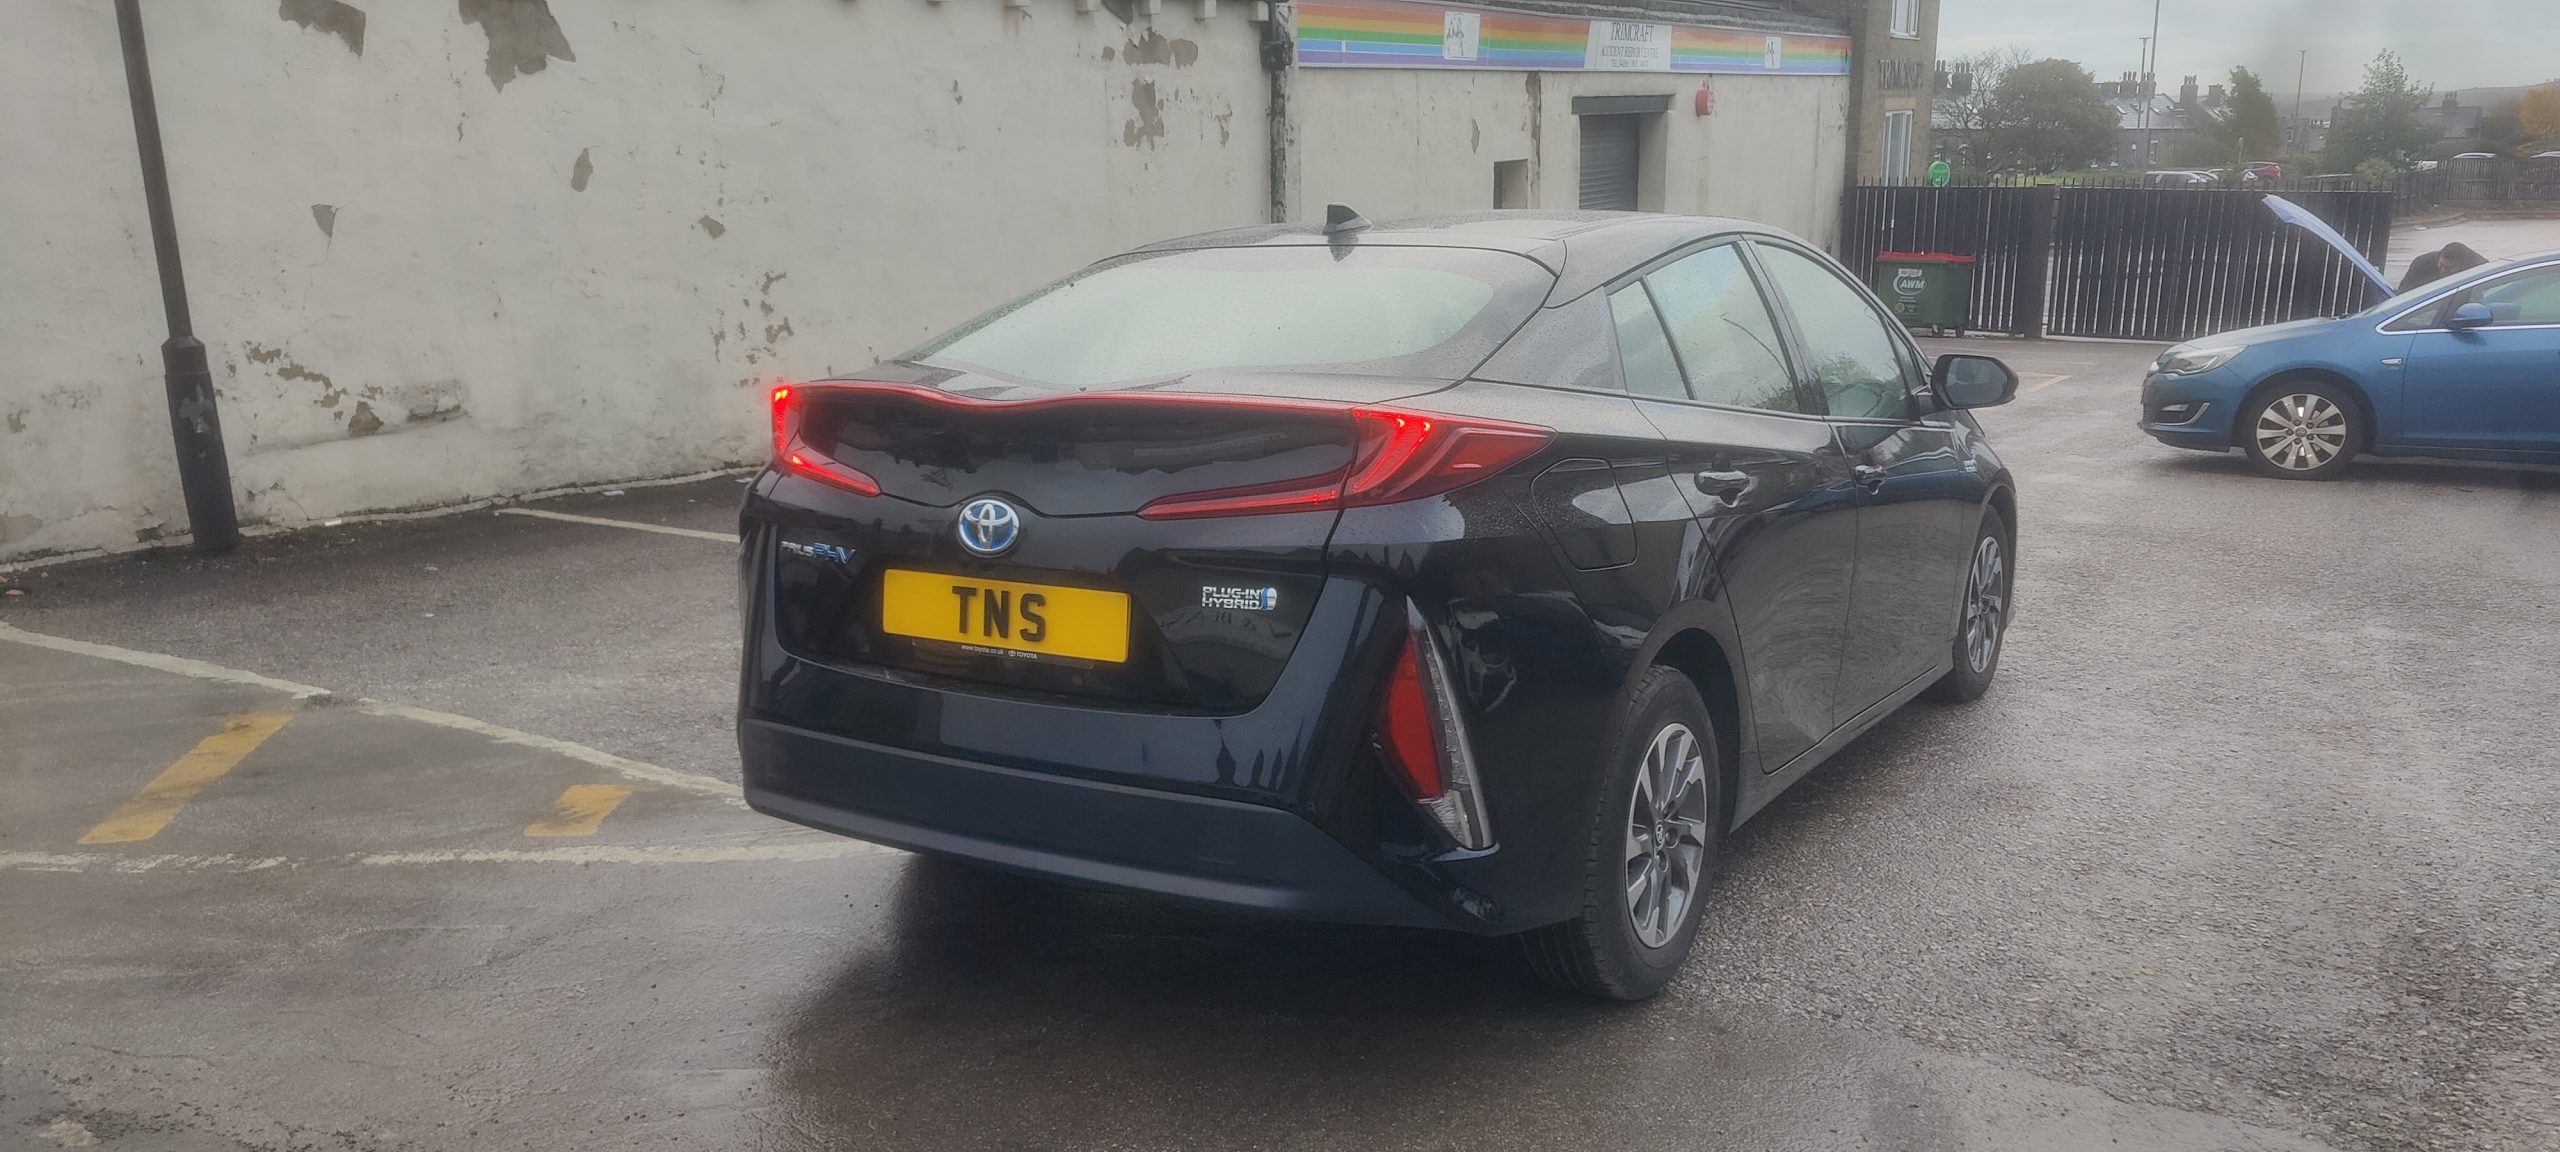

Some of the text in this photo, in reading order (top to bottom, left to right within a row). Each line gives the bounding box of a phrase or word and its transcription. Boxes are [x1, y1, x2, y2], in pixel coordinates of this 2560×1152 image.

[1610, 22, 1655, 42] TRIMCRAFT
[1900, 279, 1925, 289] AWM
[1202, 586, 1261, 599] PLUG-IN
[1201, 597, 1261, 610] HYBRID
[952, 586, 1047, 642] TNS
[1017, 651, 1038, 660] TOYOTA
